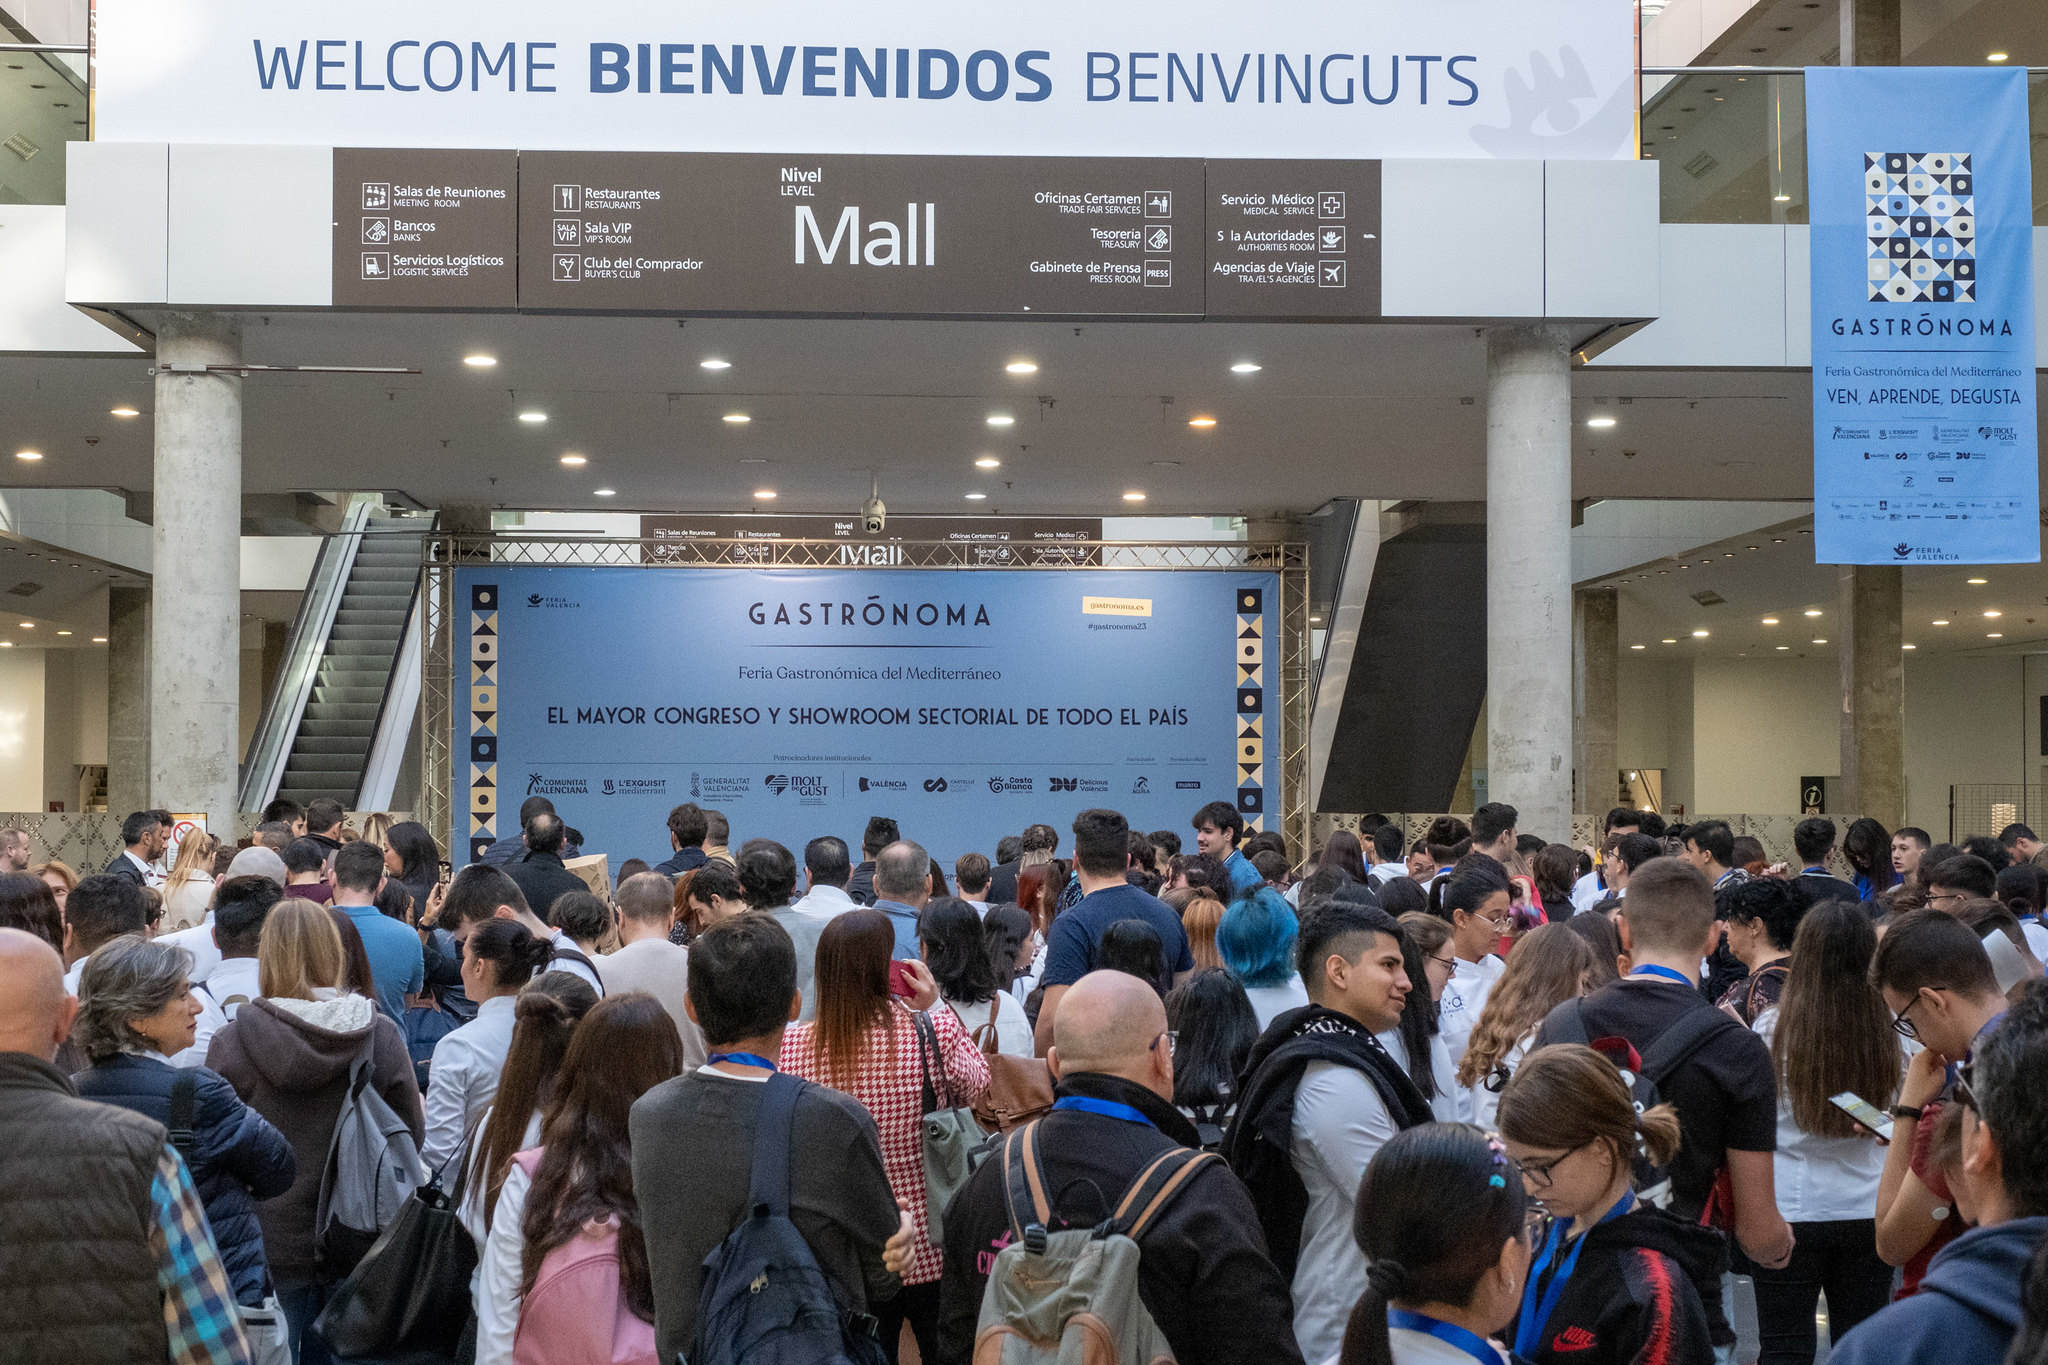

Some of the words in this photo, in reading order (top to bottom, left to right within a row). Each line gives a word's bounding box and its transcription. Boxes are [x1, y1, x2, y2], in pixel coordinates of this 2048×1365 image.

[253, 40, 557, 93] WELCOME
[590, 42, 1052, 101] BIENVENIDOS
[1087, 52, 1479, 106] BENVINGUTS
[781, 167, 822, 183] Nivel
[394, 185, 423, 197] Salas
[426, 185, 441, 197] de
[444, 187, 506, 199] Reuniones
[585, 188, 661, 200] Restaurantes
[781, 186, 815, 196] LEVEL
[1034, 191, 1081, 204] Oficinas
[1084, 193, 1141, 205] Certamen
[1221, 194, 1266, 206] Servicio
[1272, 193, 1315, 205] Médico
[394, 199, 430, 208] MEETING
[434, 200, 461, 208] ROOM
[585, 201, 641, 210] RESTAURANTS
[1059, 205, 1085, 214] TRADE
[1086, 206, 1104, 214] FAIR
[1105, 206, 1141, 214] SERVICES
[1244, 207, 1280, 215] MEDICAL
[1283, 207, 1315, 215] SERVICE
[394, 220, 436, 232] Bancos
[557, 224, 577, 232] SALA
[585, 222, 609, 234] Sala
[612, 222, 632, 234] VIP
[394, 234, 421, 242] BANKS
[557, 231, 577, 241] VIP
[795, 203, 935, 266] Mall
[1091, 228, 1142, 239] Tesorería
[1244, 230, 1315, 241] Autoridades
[585, 235, 604, 243] VIP'S
[605, 235, 632, 244] ROOM
[1100, 240, 1141, 249] TREASURY
[1237, 243, 1288, 252] AUTHORITIES
[1290, 243, 1315, 252] ROOM
[394, 255, 444, 266] Servicios
[447, 255, 504, 269] Logísticos
[584, 257, 612, 269] Club
[614, 257, 633, 269] del
[636, 258, 704, 272] Comprador
[394, 268, 430, 276] LOGISTIC
[432, 268, 469, 276] SERVICES
[1030, 261, 1083, 274] Gabinete
[1086, 262, 1101, 274] de
[1104, 262, 1142, 274] Prensa
[1213, 262, 1266, 275] Agencias
[1268, 262, 1283, 273] de
[1286, 262, 1315, 276] Viaje
[585, 270, 618, 278] BUYER'S
[620, 270, 641, 279] CLUB
[1146, 269, 1169, 278] PRESS
[1090, 275, 1113, 283] PRESS
[1115, 275, 1141, 284] ROOM
[1276, 275, 1315, 284] AGENCIES
[1825, 366, 1851, 377] Feria
[1853, 366, 1930, 377] Gastronómica
[1931, 366, 1949, 377] del
[1950, 366, 2022, 377] Mediterráneo
[1827, 389, 1862, 406] VEN,
[1869, 389, 1944, 406] APRENDE,
[1951, 389, 2022, 404] DEGUSTA
[835, 522, 853, 530] Nivel
[1090, 602, 1145, 612] gastronoma.es
[1087, 623, 1147, 631] #gastronoma23
[739, 666, 773, 680] Feria
[776, 666, 878, 680] Gastronómica
[881, 666, 902, 680] del
[906, 667, 1002, 681] Mediterráneo
[548, 706, 569, 724] EL
[577, 706, 646, 724] MAYOR
[654, 706, 760, 725] CONGRESO
[768, 707, 781, 724] Y
[789, 707, 910, 725] SHOWROOM
[918, 707, 1019, 725] SECTORIAL
[1026, 708, 1049, 725] DE
[1057, 708, 1113, 725] TODO
[1120, 708, 1141, 725] EL
[1149, 704, 1188, 725] PAÍS
[619, 779, 666, 787] L'EXQUISIT
[619, 786, 666, 794] mediterrani
[799, 786, 828, 796] GUST
